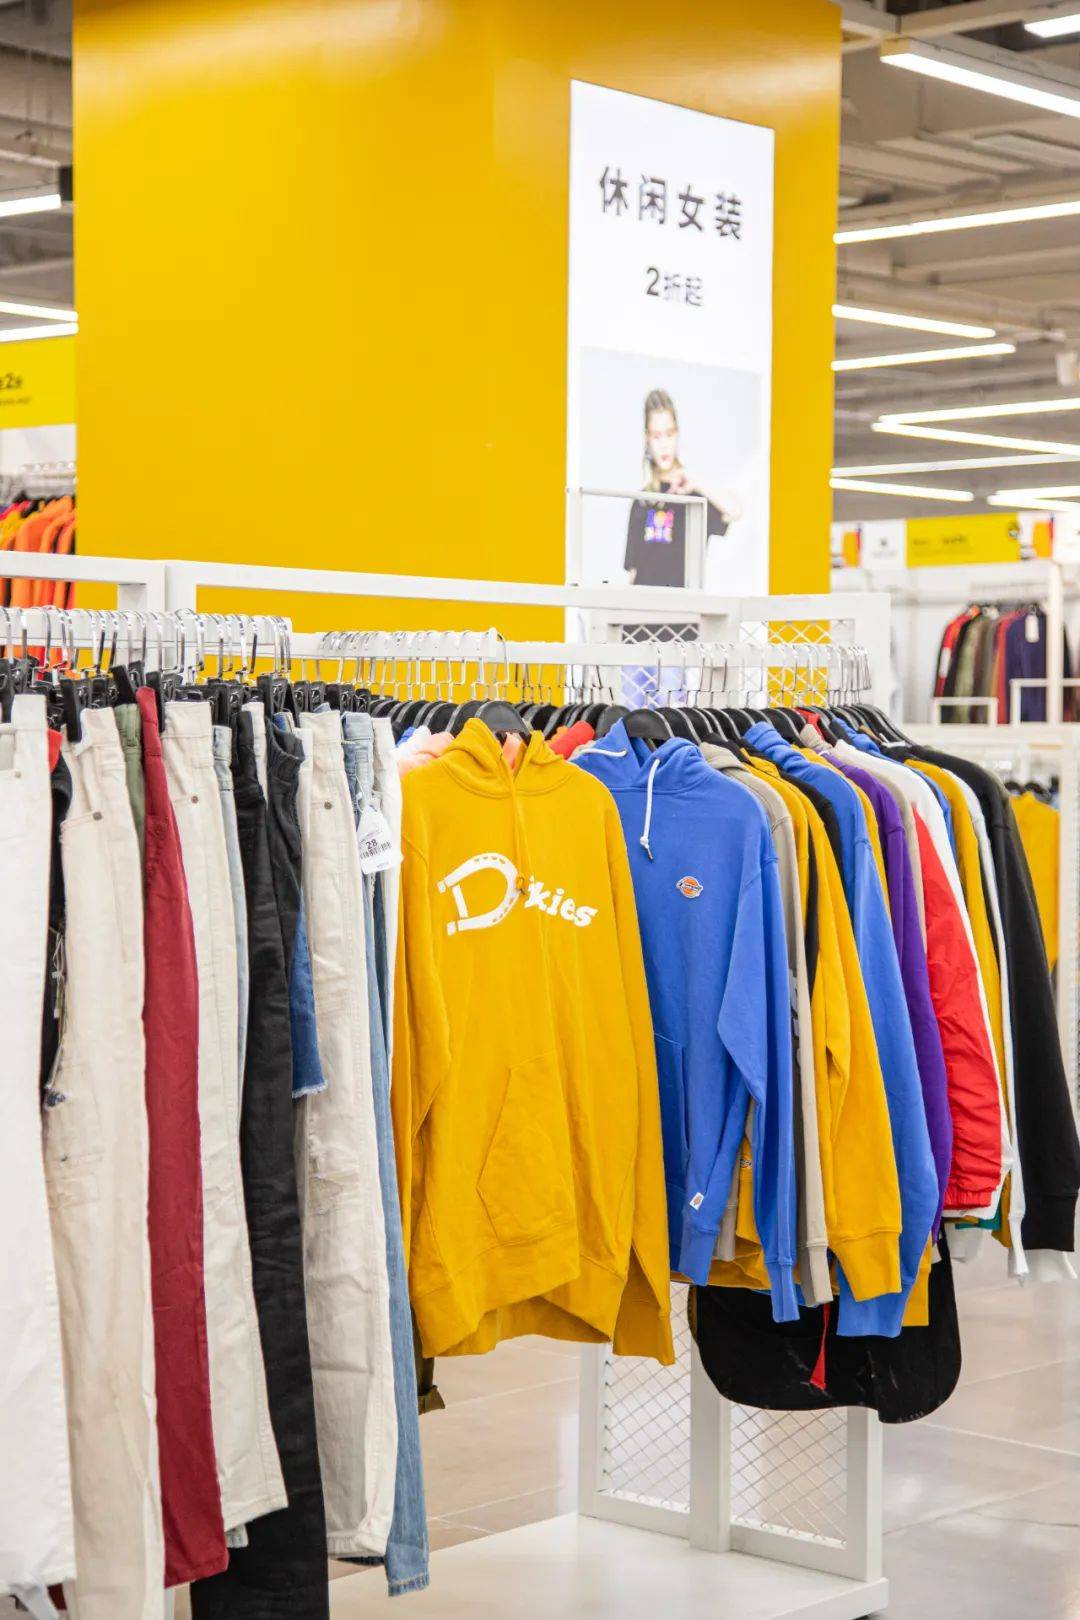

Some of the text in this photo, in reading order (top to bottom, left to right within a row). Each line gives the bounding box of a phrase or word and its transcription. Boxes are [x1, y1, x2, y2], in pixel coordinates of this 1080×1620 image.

[599, 166, 742, 240] 休闲女装
[365, 839, 378, 850] 28
